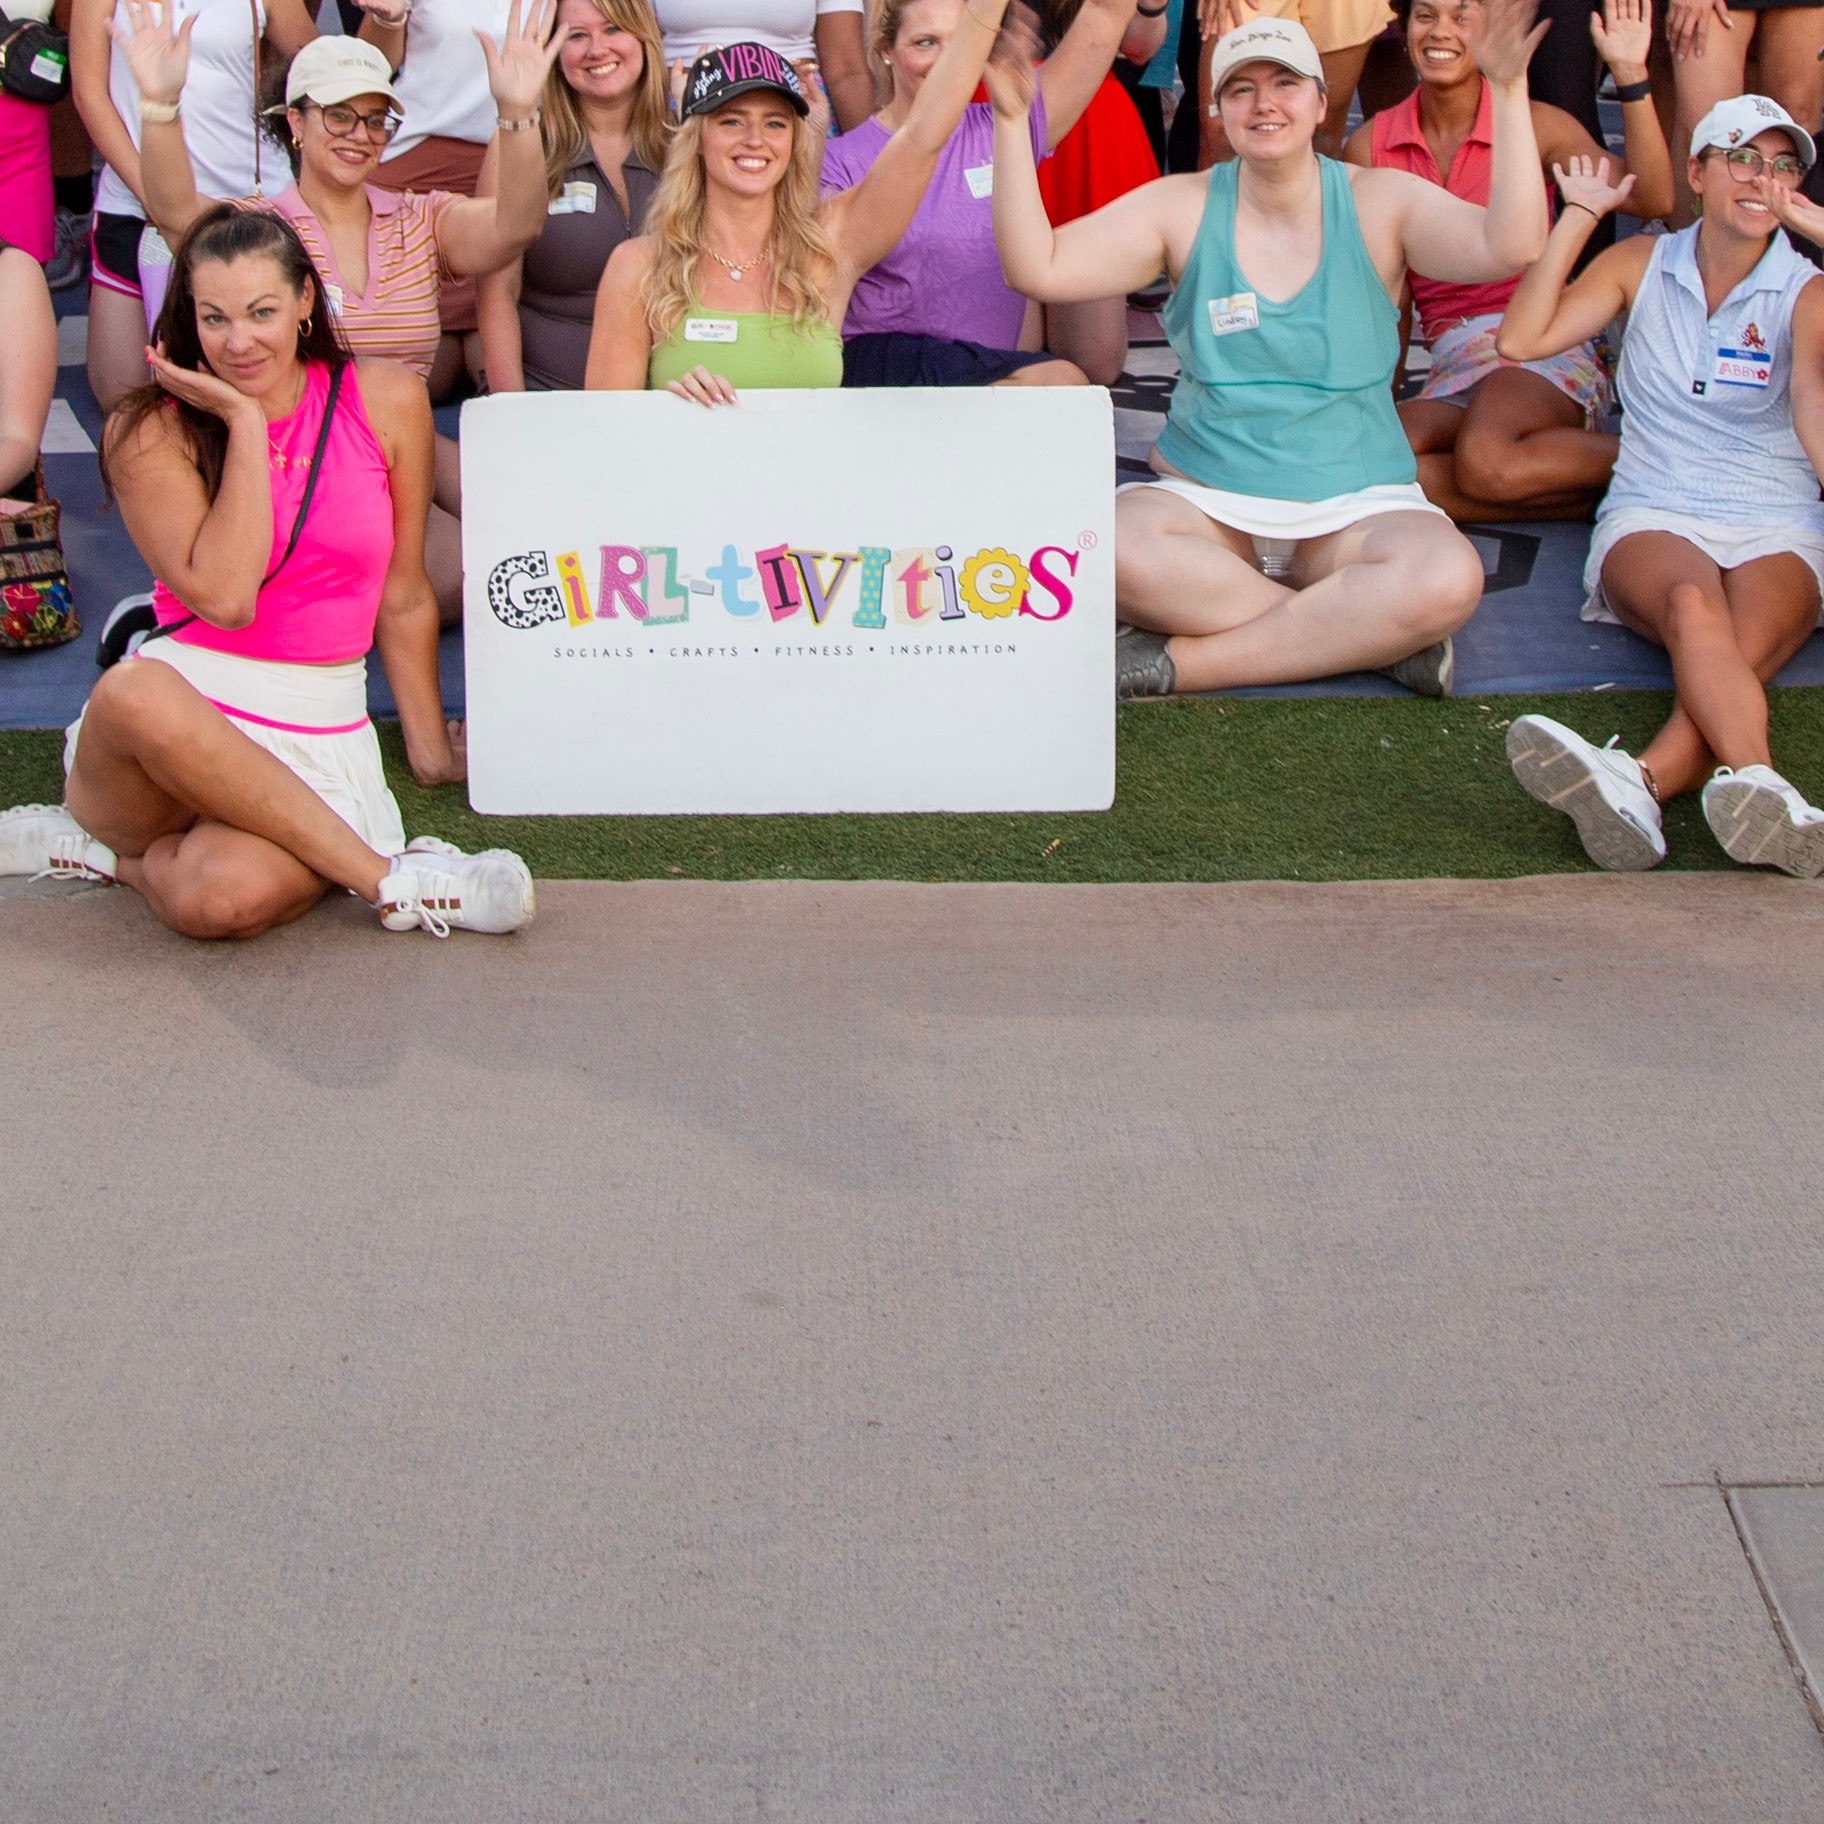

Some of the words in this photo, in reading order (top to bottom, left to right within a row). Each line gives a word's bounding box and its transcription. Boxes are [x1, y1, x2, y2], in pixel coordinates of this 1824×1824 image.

[554, 647, 635, 658] SOCIALS
[669, 646, 740, 657] CRAFTS
[775, 645, 856, 656] FITNESS
[889, 643, 1018, 654] INSPIRATION
